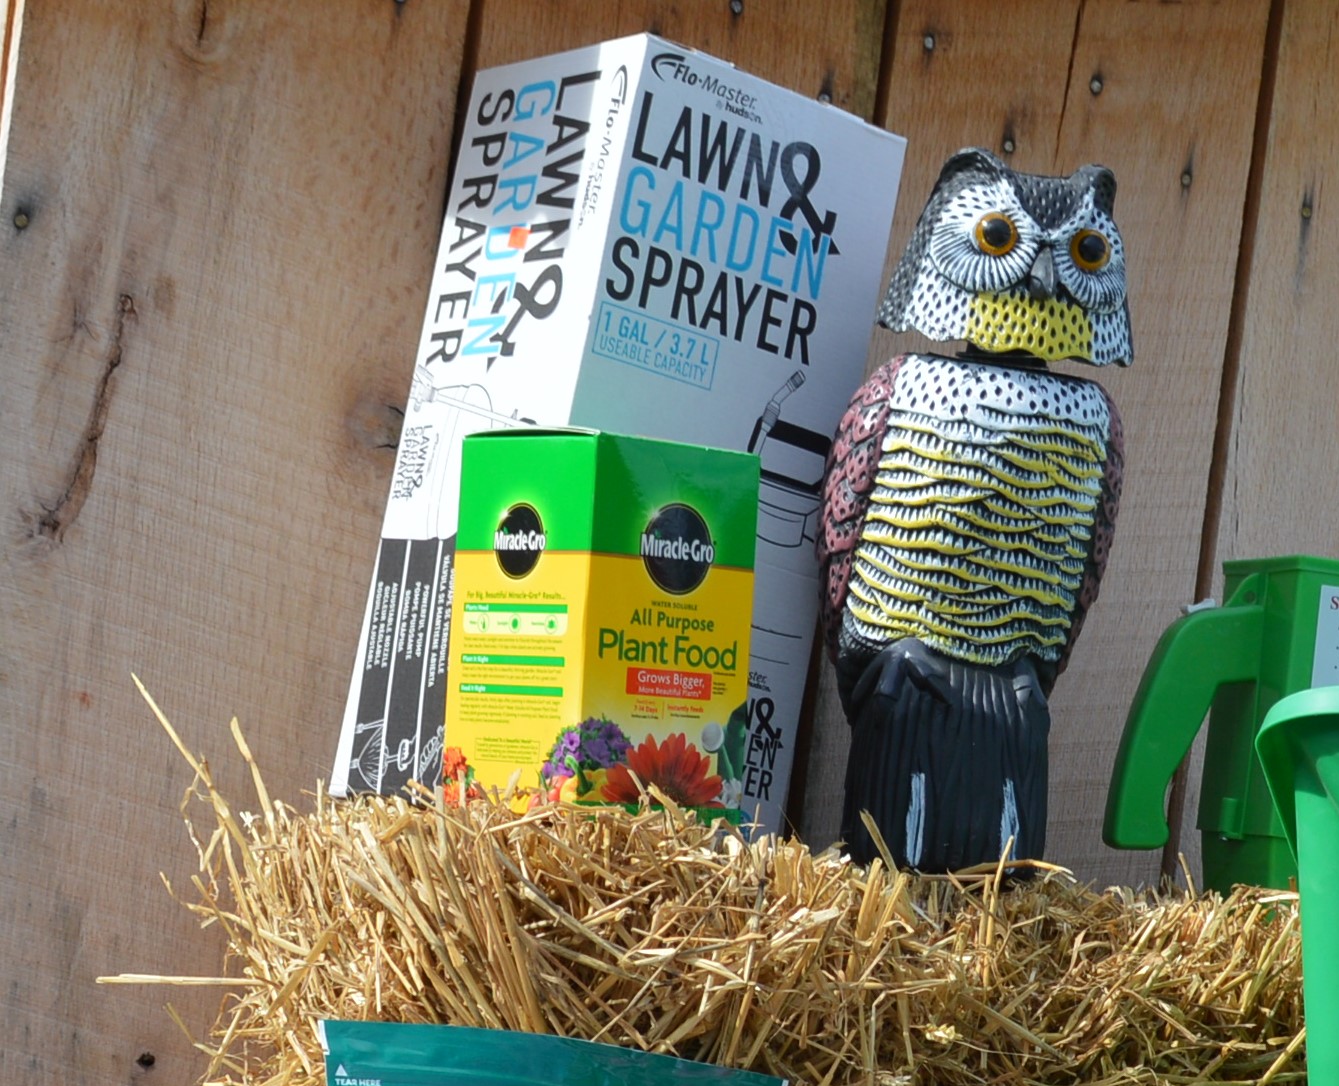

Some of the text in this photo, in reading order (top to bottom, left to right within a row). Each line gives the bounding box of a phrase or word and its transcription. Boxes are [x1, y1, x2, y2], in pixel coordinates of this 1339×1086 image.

[523, 70, 602, 263] LAWN
[631, 90, 840, 256] LAWN &
[425, 89, 515, 366] SPRAYER
[461, 80, 556, 356] GARDEN
[619, 166, 831, 300] GARDEN
[606, 236, 818, 366] SPRAYER
[600, 334, 707, 383] USEABLE CAPACITY
[618, 316, 709, 365] GAL 3.7 L
[641, 533, 714, 564] Miracle-Gro
[630, 608, 714, 634] All Purpose
[598, 628, 668, 665] Plant
[674, 635, 737, 671] Food
[638, 670, 705, 689] Grows Bigger,
[638, 686, 681, 697] More Beautiful
[335, 1078, 358, 1086] TEAR
